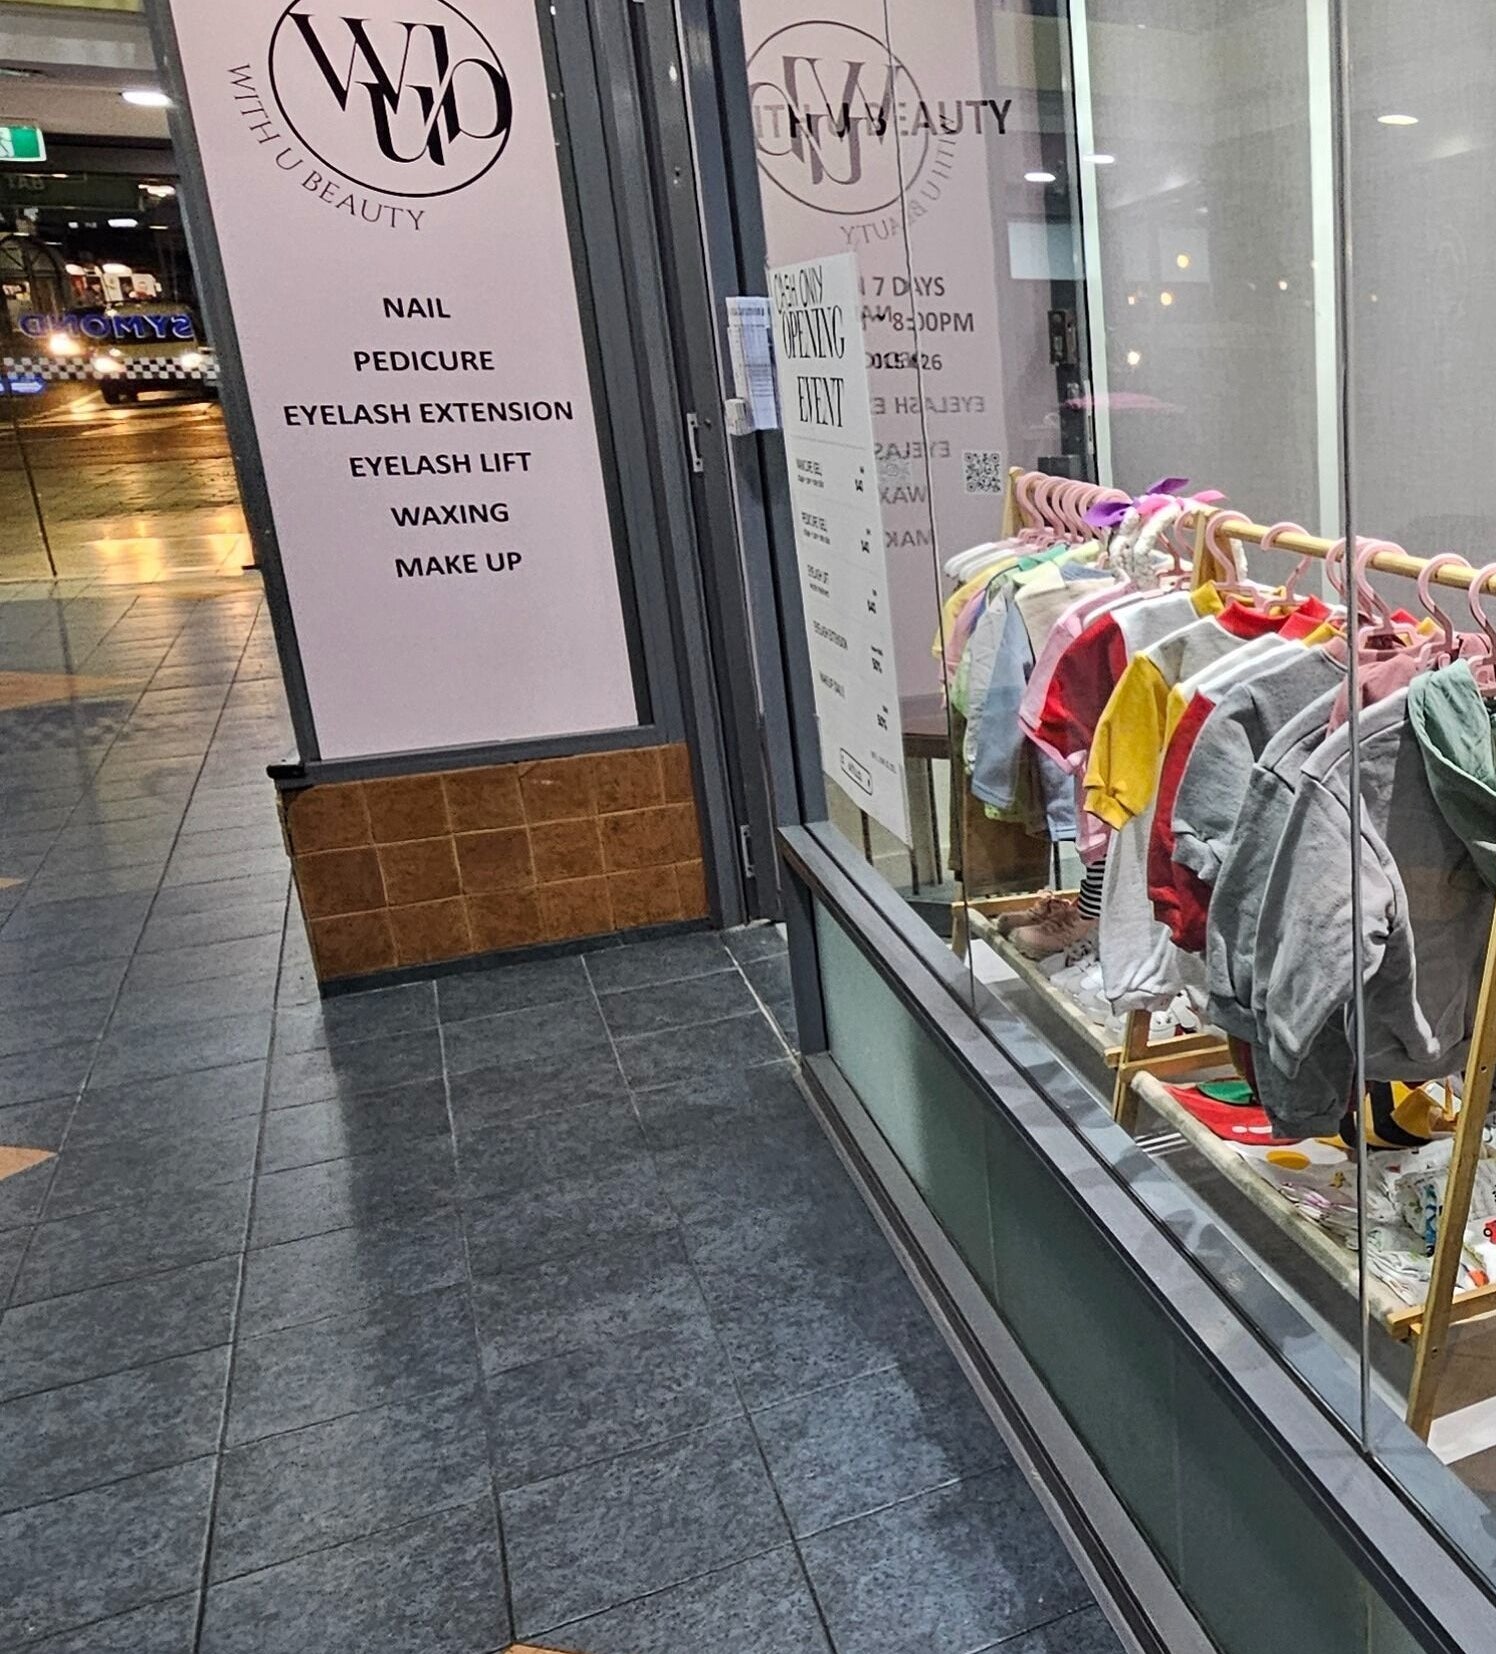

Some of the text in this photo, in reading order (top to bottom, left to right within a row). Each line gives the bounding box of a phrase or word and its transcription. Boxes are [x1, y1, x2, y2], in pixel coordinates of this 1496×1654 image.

[227, 63, 426, 231] WITH U BEAUTY
[799, 265, 823, 308] ONLY
[872, 276, 885, 297] 7
[382, 297, 451, 319] NAIL
[782, 304, 846, 360] OPENING
[353, 350, 495, 372] PEDICURE
[283, 400, 573, 426] EYELASH EXTENSION
[797, 375, 845, 429] EVENT
[349, 452, 531, 478] EYELASH LIFT
[391, 502, 510, 527] WAXING
[395, 551, 522, 578] MAKE UP
